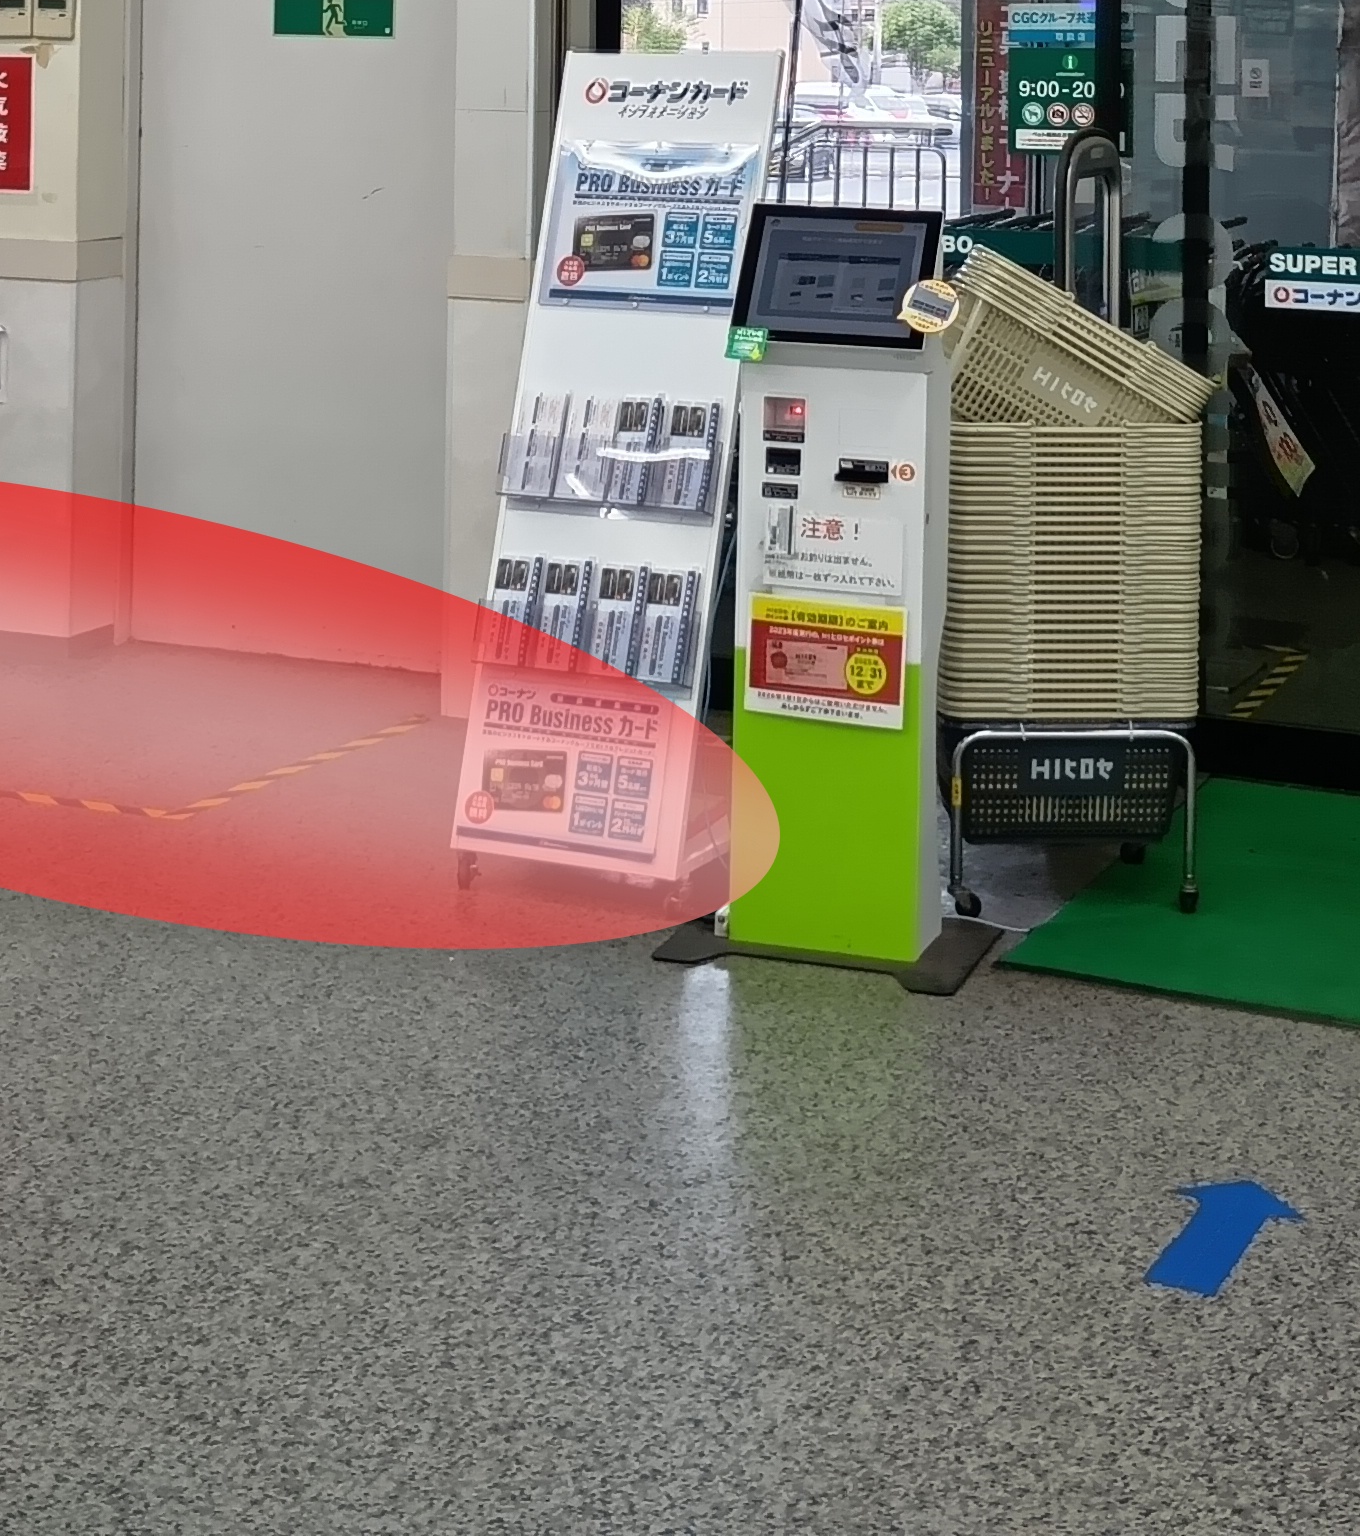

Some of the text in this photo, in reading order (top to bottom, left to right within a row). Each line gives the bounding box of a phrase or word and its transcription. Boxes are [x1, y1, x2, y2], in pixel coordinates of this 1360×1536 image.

[608, 80, 749, 105] コーナンカード
[575, 171, 615, 194] PRO
[1269, 252, 1358, 278] SUPER
[486, 699, 524, 723] PRO
[529, 704, 614, 735] Business
[618, 715, 659, 739] カード
